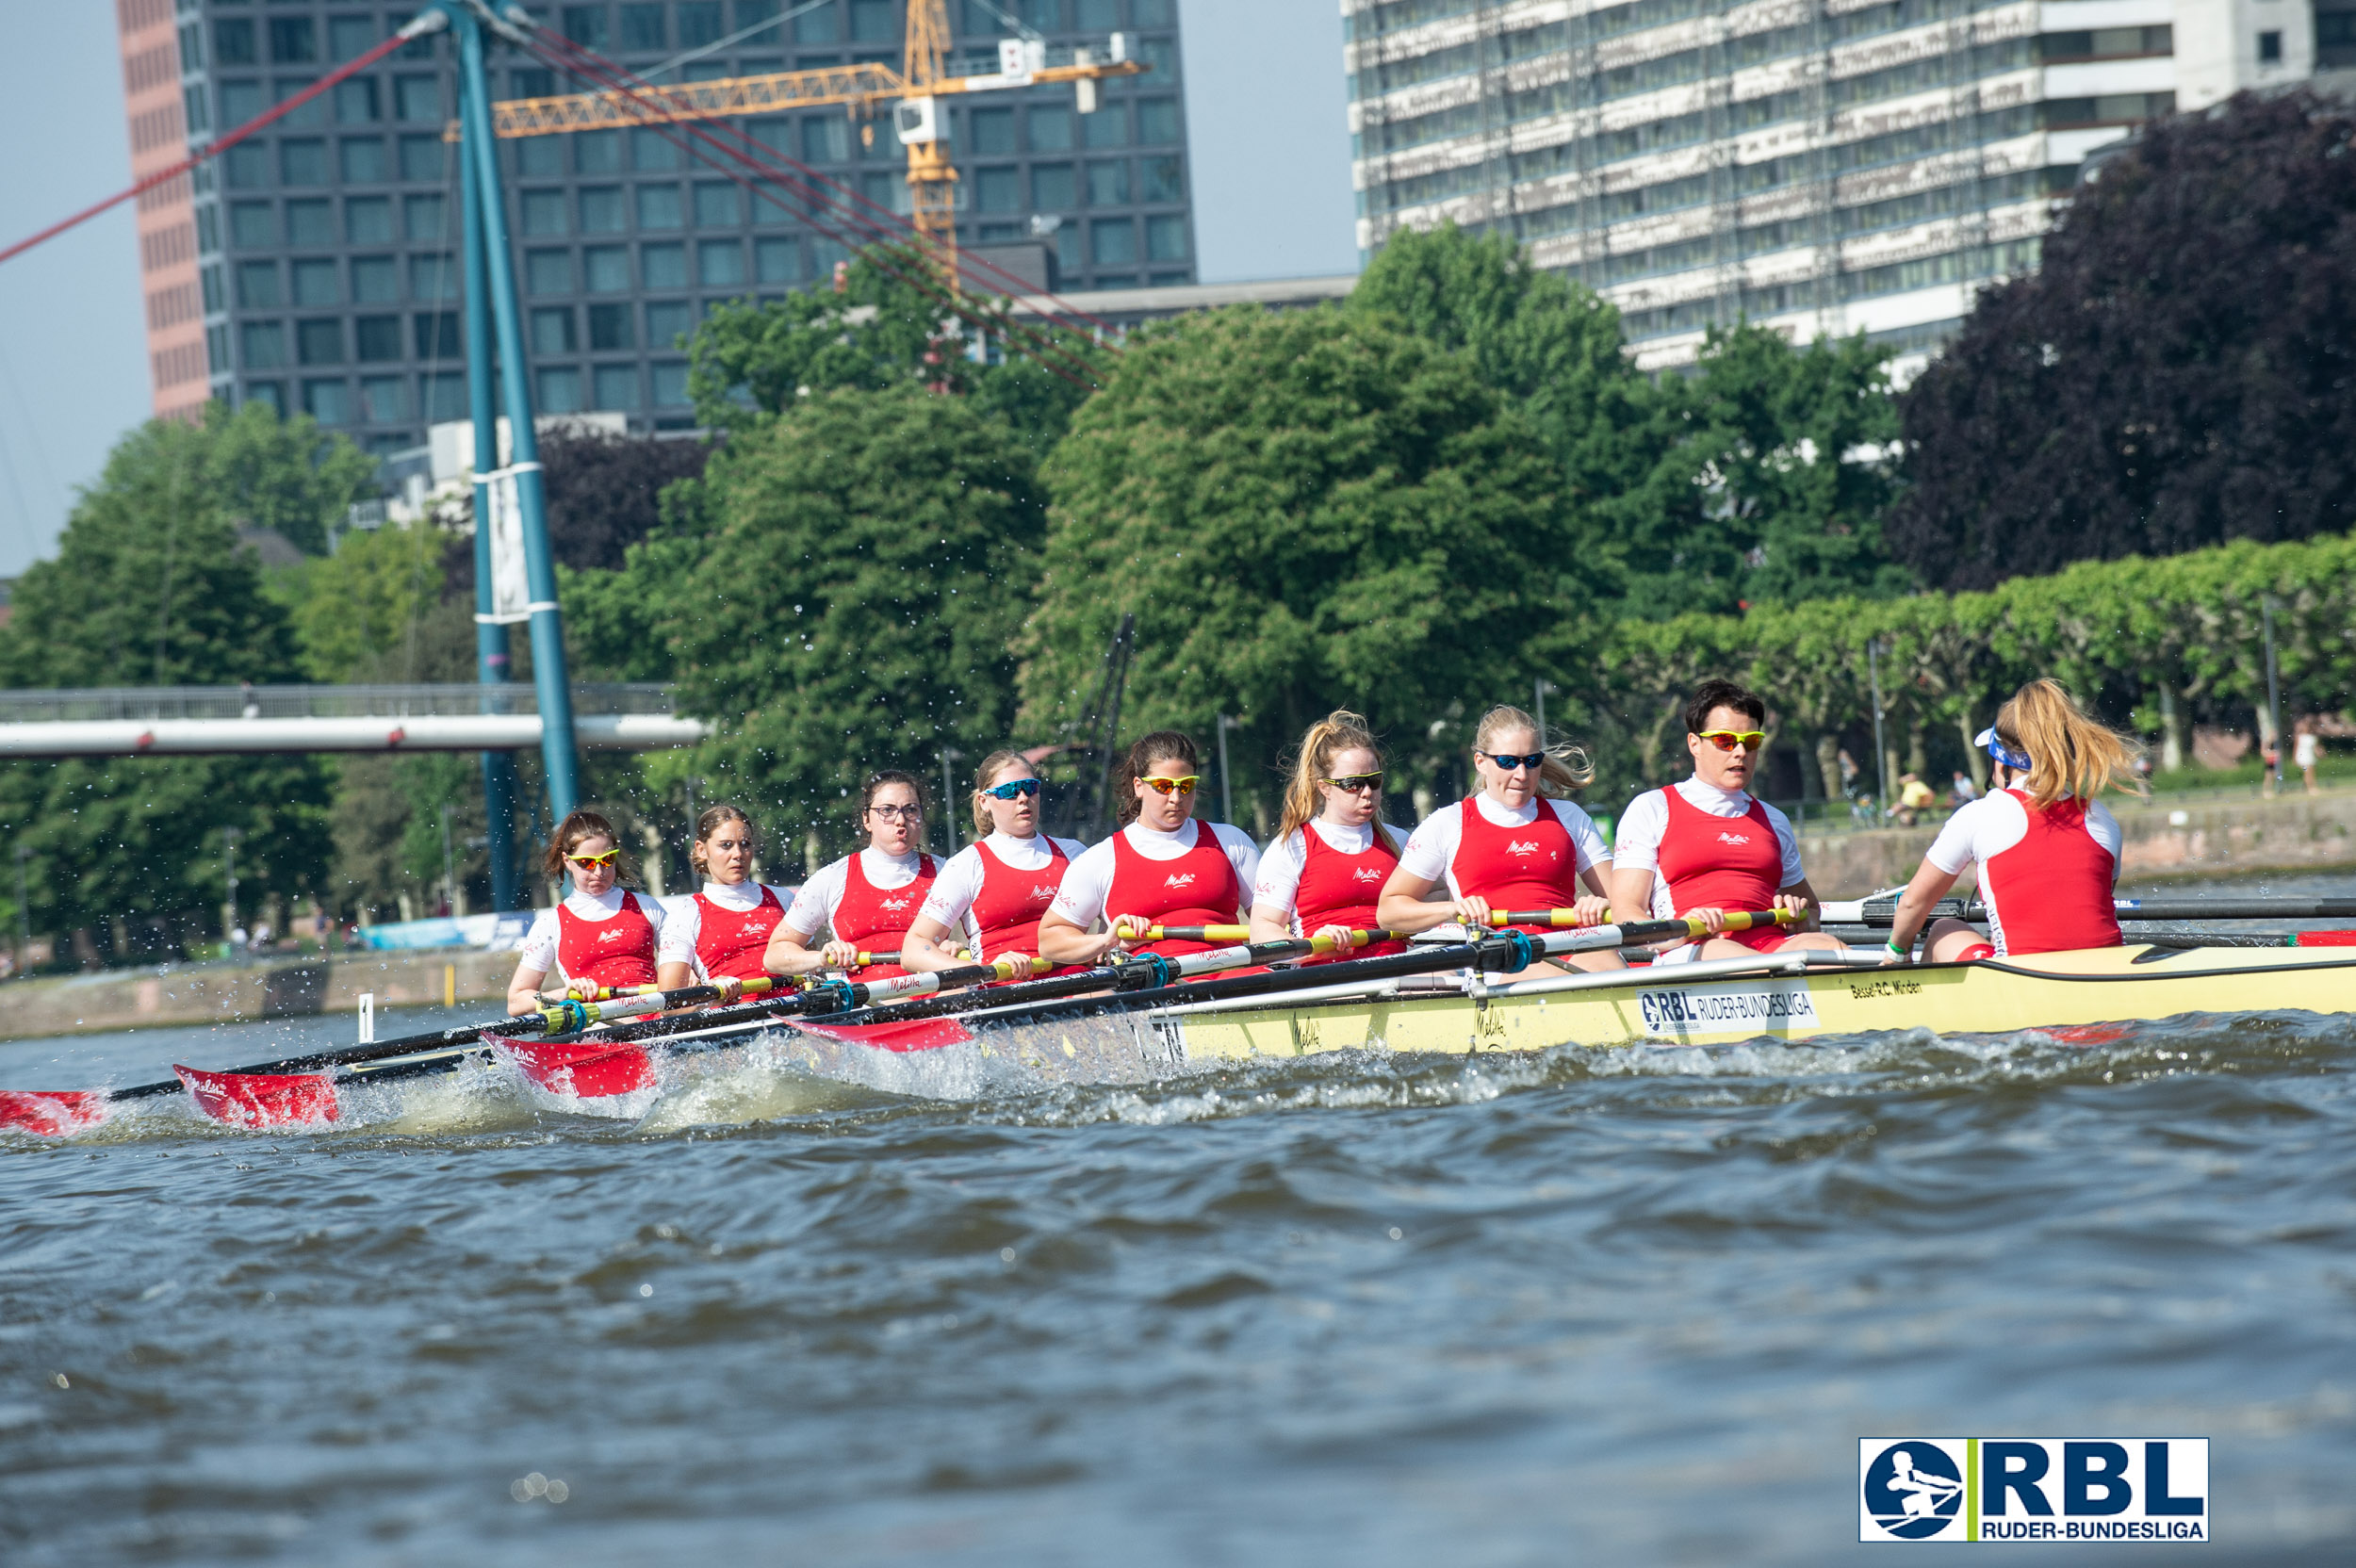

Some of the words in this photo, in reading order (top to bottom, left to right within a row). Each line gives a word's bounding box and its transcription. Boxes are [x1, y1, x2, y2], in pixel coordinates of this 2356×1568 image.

[1506, 840, 1539, 856] Melitta
[1164, 874, 1196, 888] Melitta
[1352, 867, 1382, 882] Melitta
[1030, 885, 1057, 899] Melitta
[880, 898, 909, 910] Melitta
[888, 979, 922, 993] Melitta
[1892, 979, 1923, 995] Minden
[617, 997, 649, 1008] Melitta
[1658, 992, 1697, 1021] RBL
[1698, 992, 1813, 1021] RUDER-BUNDESLIGA
[1474, 1002, 1507, 1038] Melitta
[1292, 1010, 1321, 1049] Melitta
